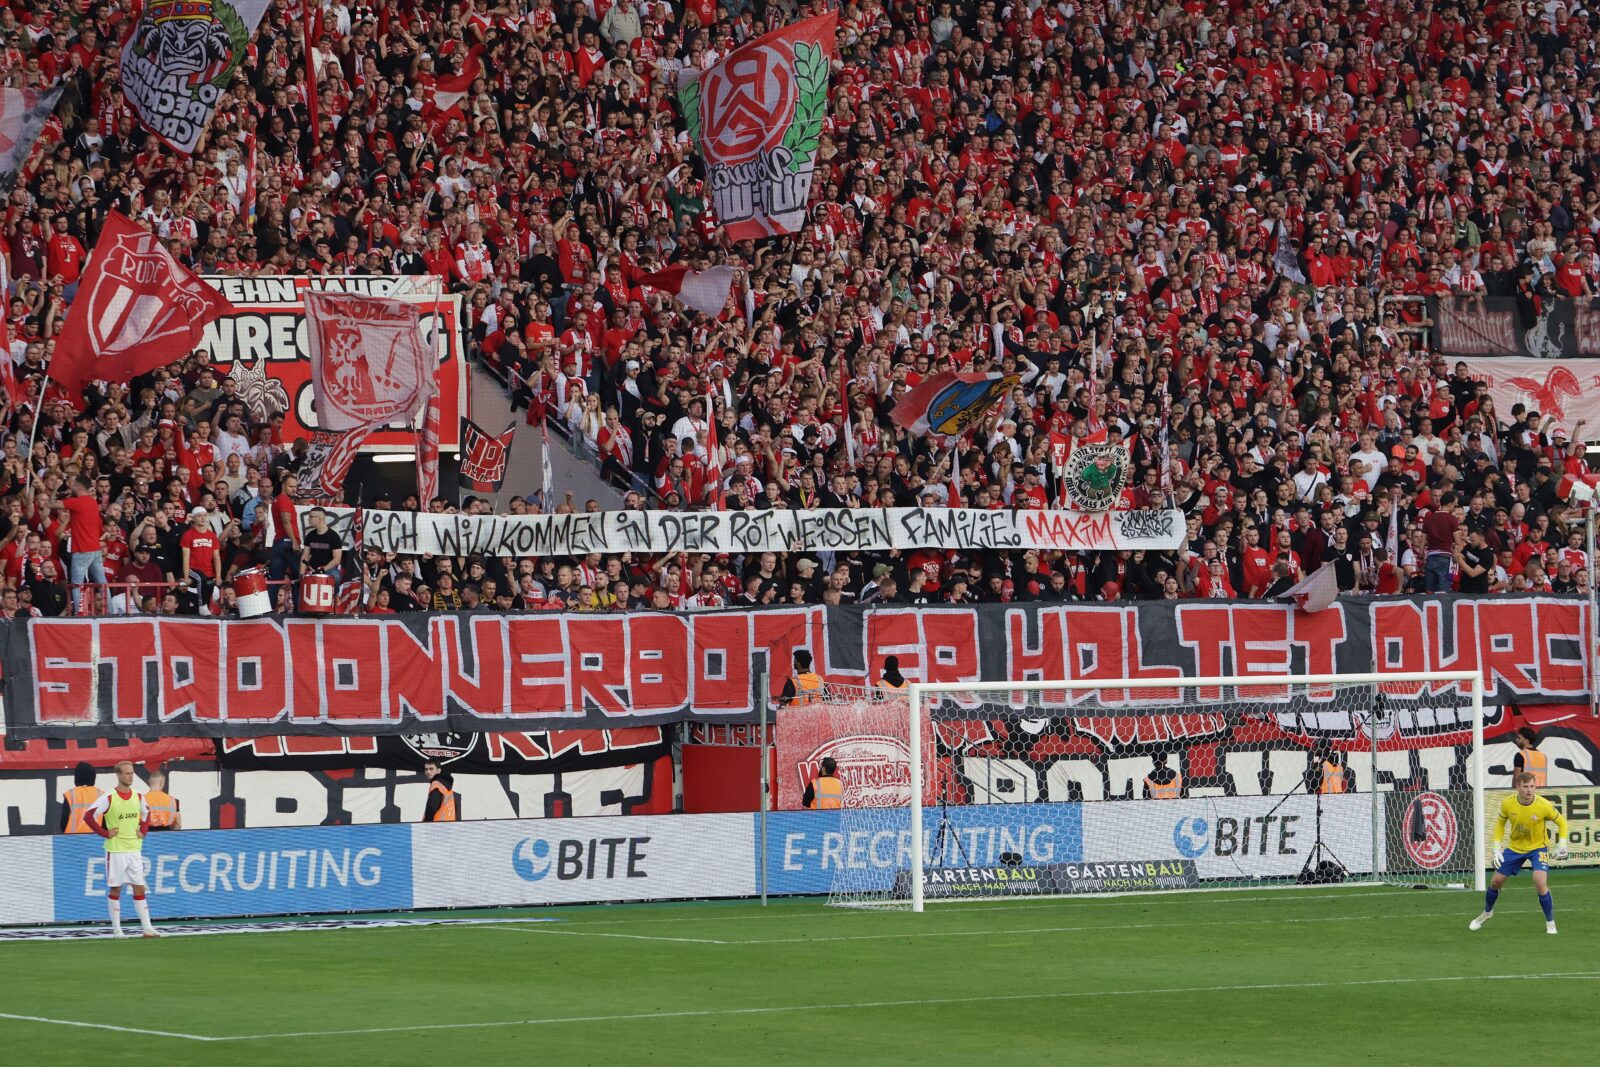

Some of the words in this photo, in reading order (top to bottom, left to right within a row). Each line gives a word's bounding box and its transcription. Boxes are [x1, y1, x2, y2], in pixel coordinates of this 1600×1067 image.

[658, 514, 720, 550] DER
[304, 584, 332, 606] UD
[1215, 815, 1301, 857] BITE
[556, 836, 651, 880] BITE
[1067, 862, 1184, 879] GARTENBAU
[1103, 879, 1132, 888] NACH
